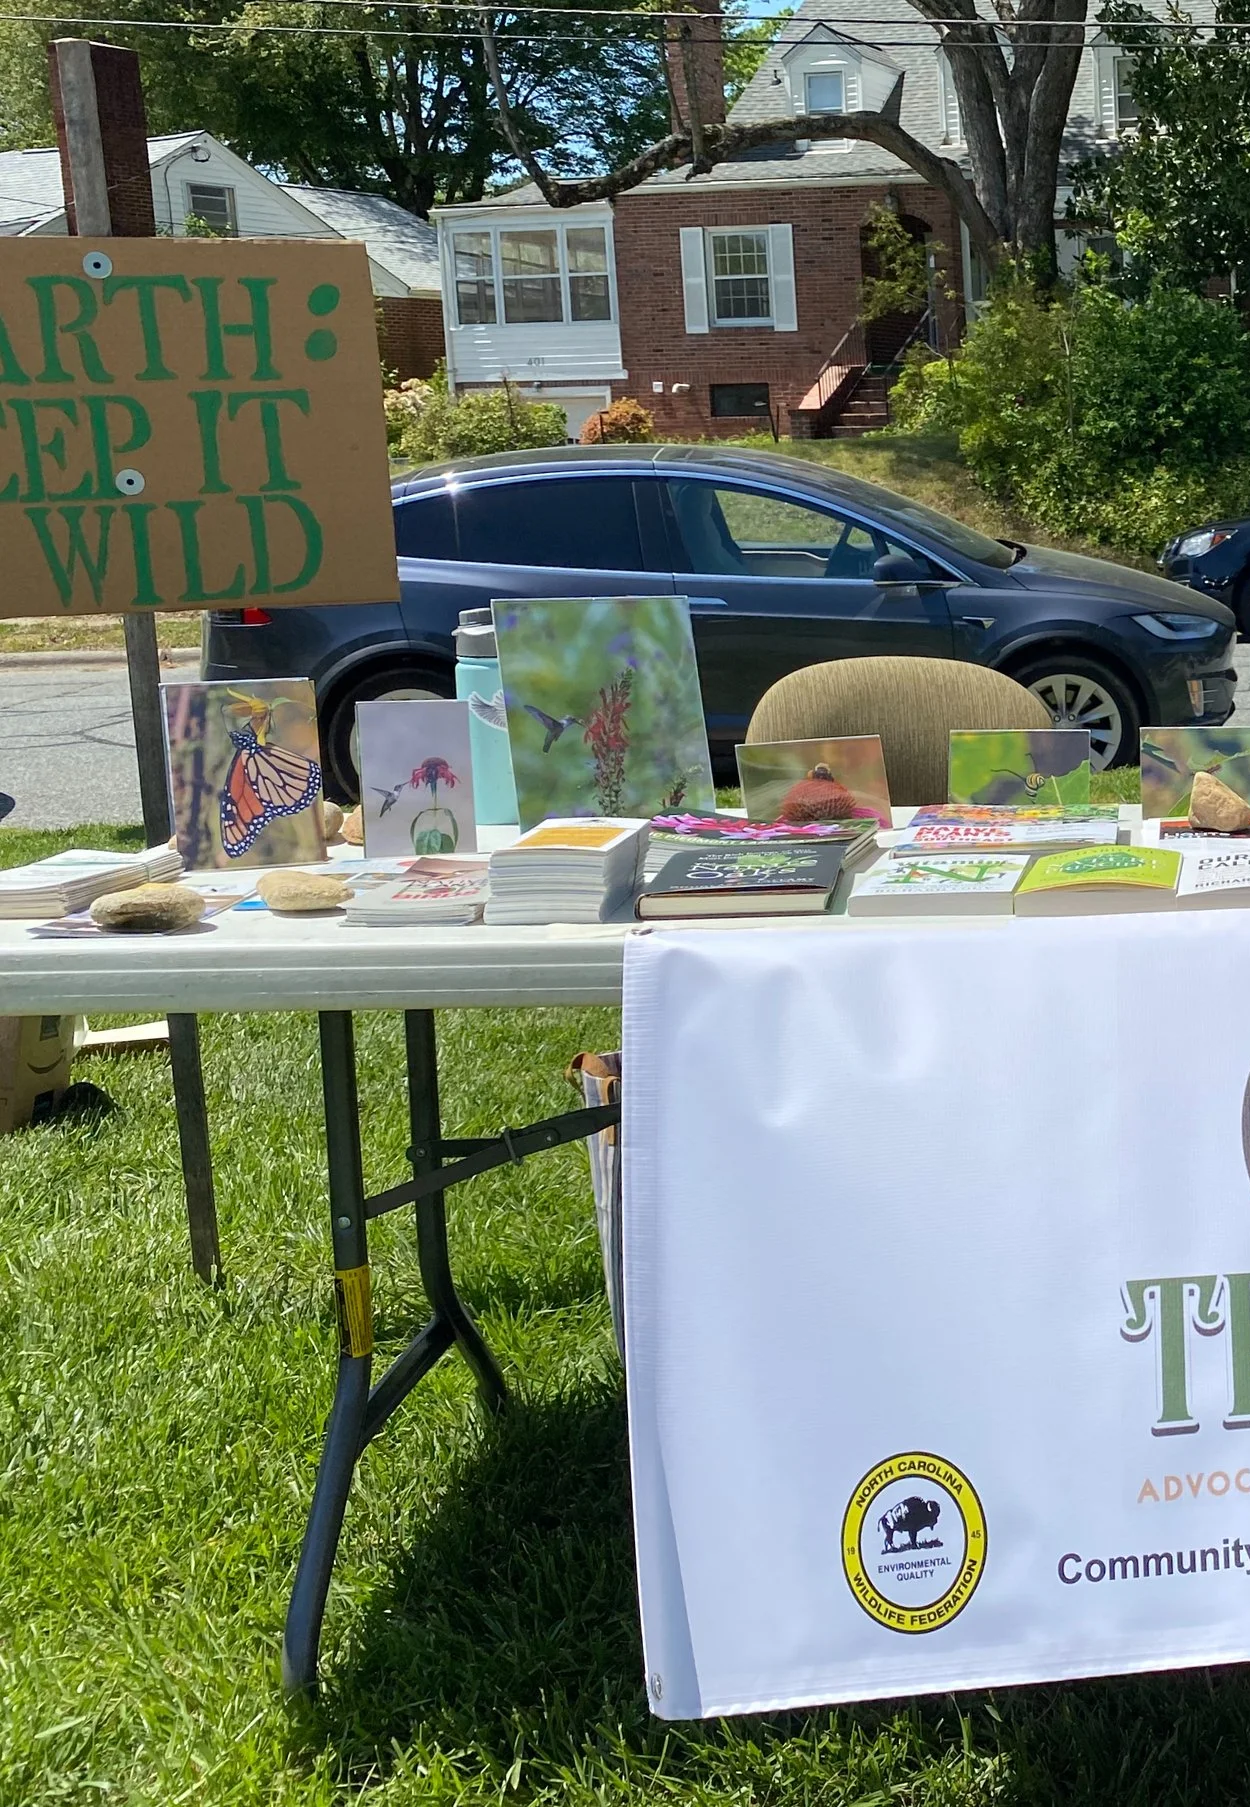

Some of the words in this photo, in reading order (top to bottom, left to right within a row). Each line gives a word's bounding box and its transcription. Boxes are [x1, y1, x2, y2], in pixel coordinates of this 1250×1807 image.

[188, 388, 311, 494] IT
[25, 494, 324, 608] WILD
[1199, 853, 1249, 865] OUR
[855, 1466, 895, 1509] NORTH
[897, 1460, 964, 1497] CAROLINA
[970, 1529, 982, 1540] 45
[846, 1547, 856, 1556] 19
[877, 1557, 953, 1574] ENVIRONMENTAL
[896, 1569, 935, 1582] QUALITY
[852, 1572, 906, 1625] WILDLIFE
[910, 1558, 978, 1626] FEDERATION
